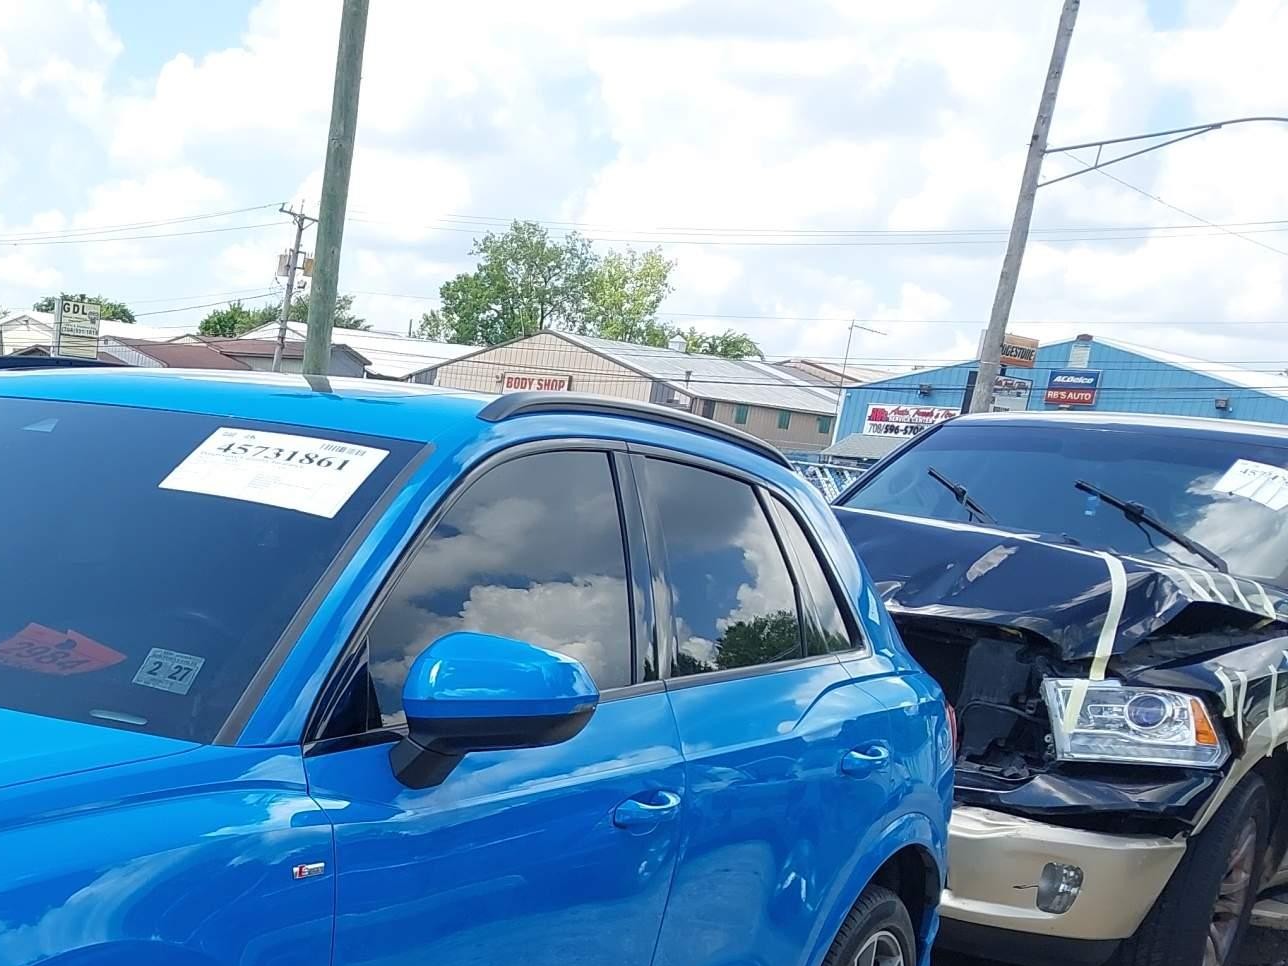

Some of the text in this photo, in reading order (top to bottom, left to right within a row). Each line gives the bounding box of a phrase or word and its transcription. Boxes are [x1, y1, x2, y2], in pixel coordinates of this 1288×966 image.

[63, 303, 88, 315] GDL
[506, 376, 565, 391] BODY SHOP
[1053, 375, 1095, 384] ACDelco
[1047, 391, 1092, 401] RB'S AUTO
[216, 442, 350, 471] 45731861
[146, 661, 193, 682] 2 27
